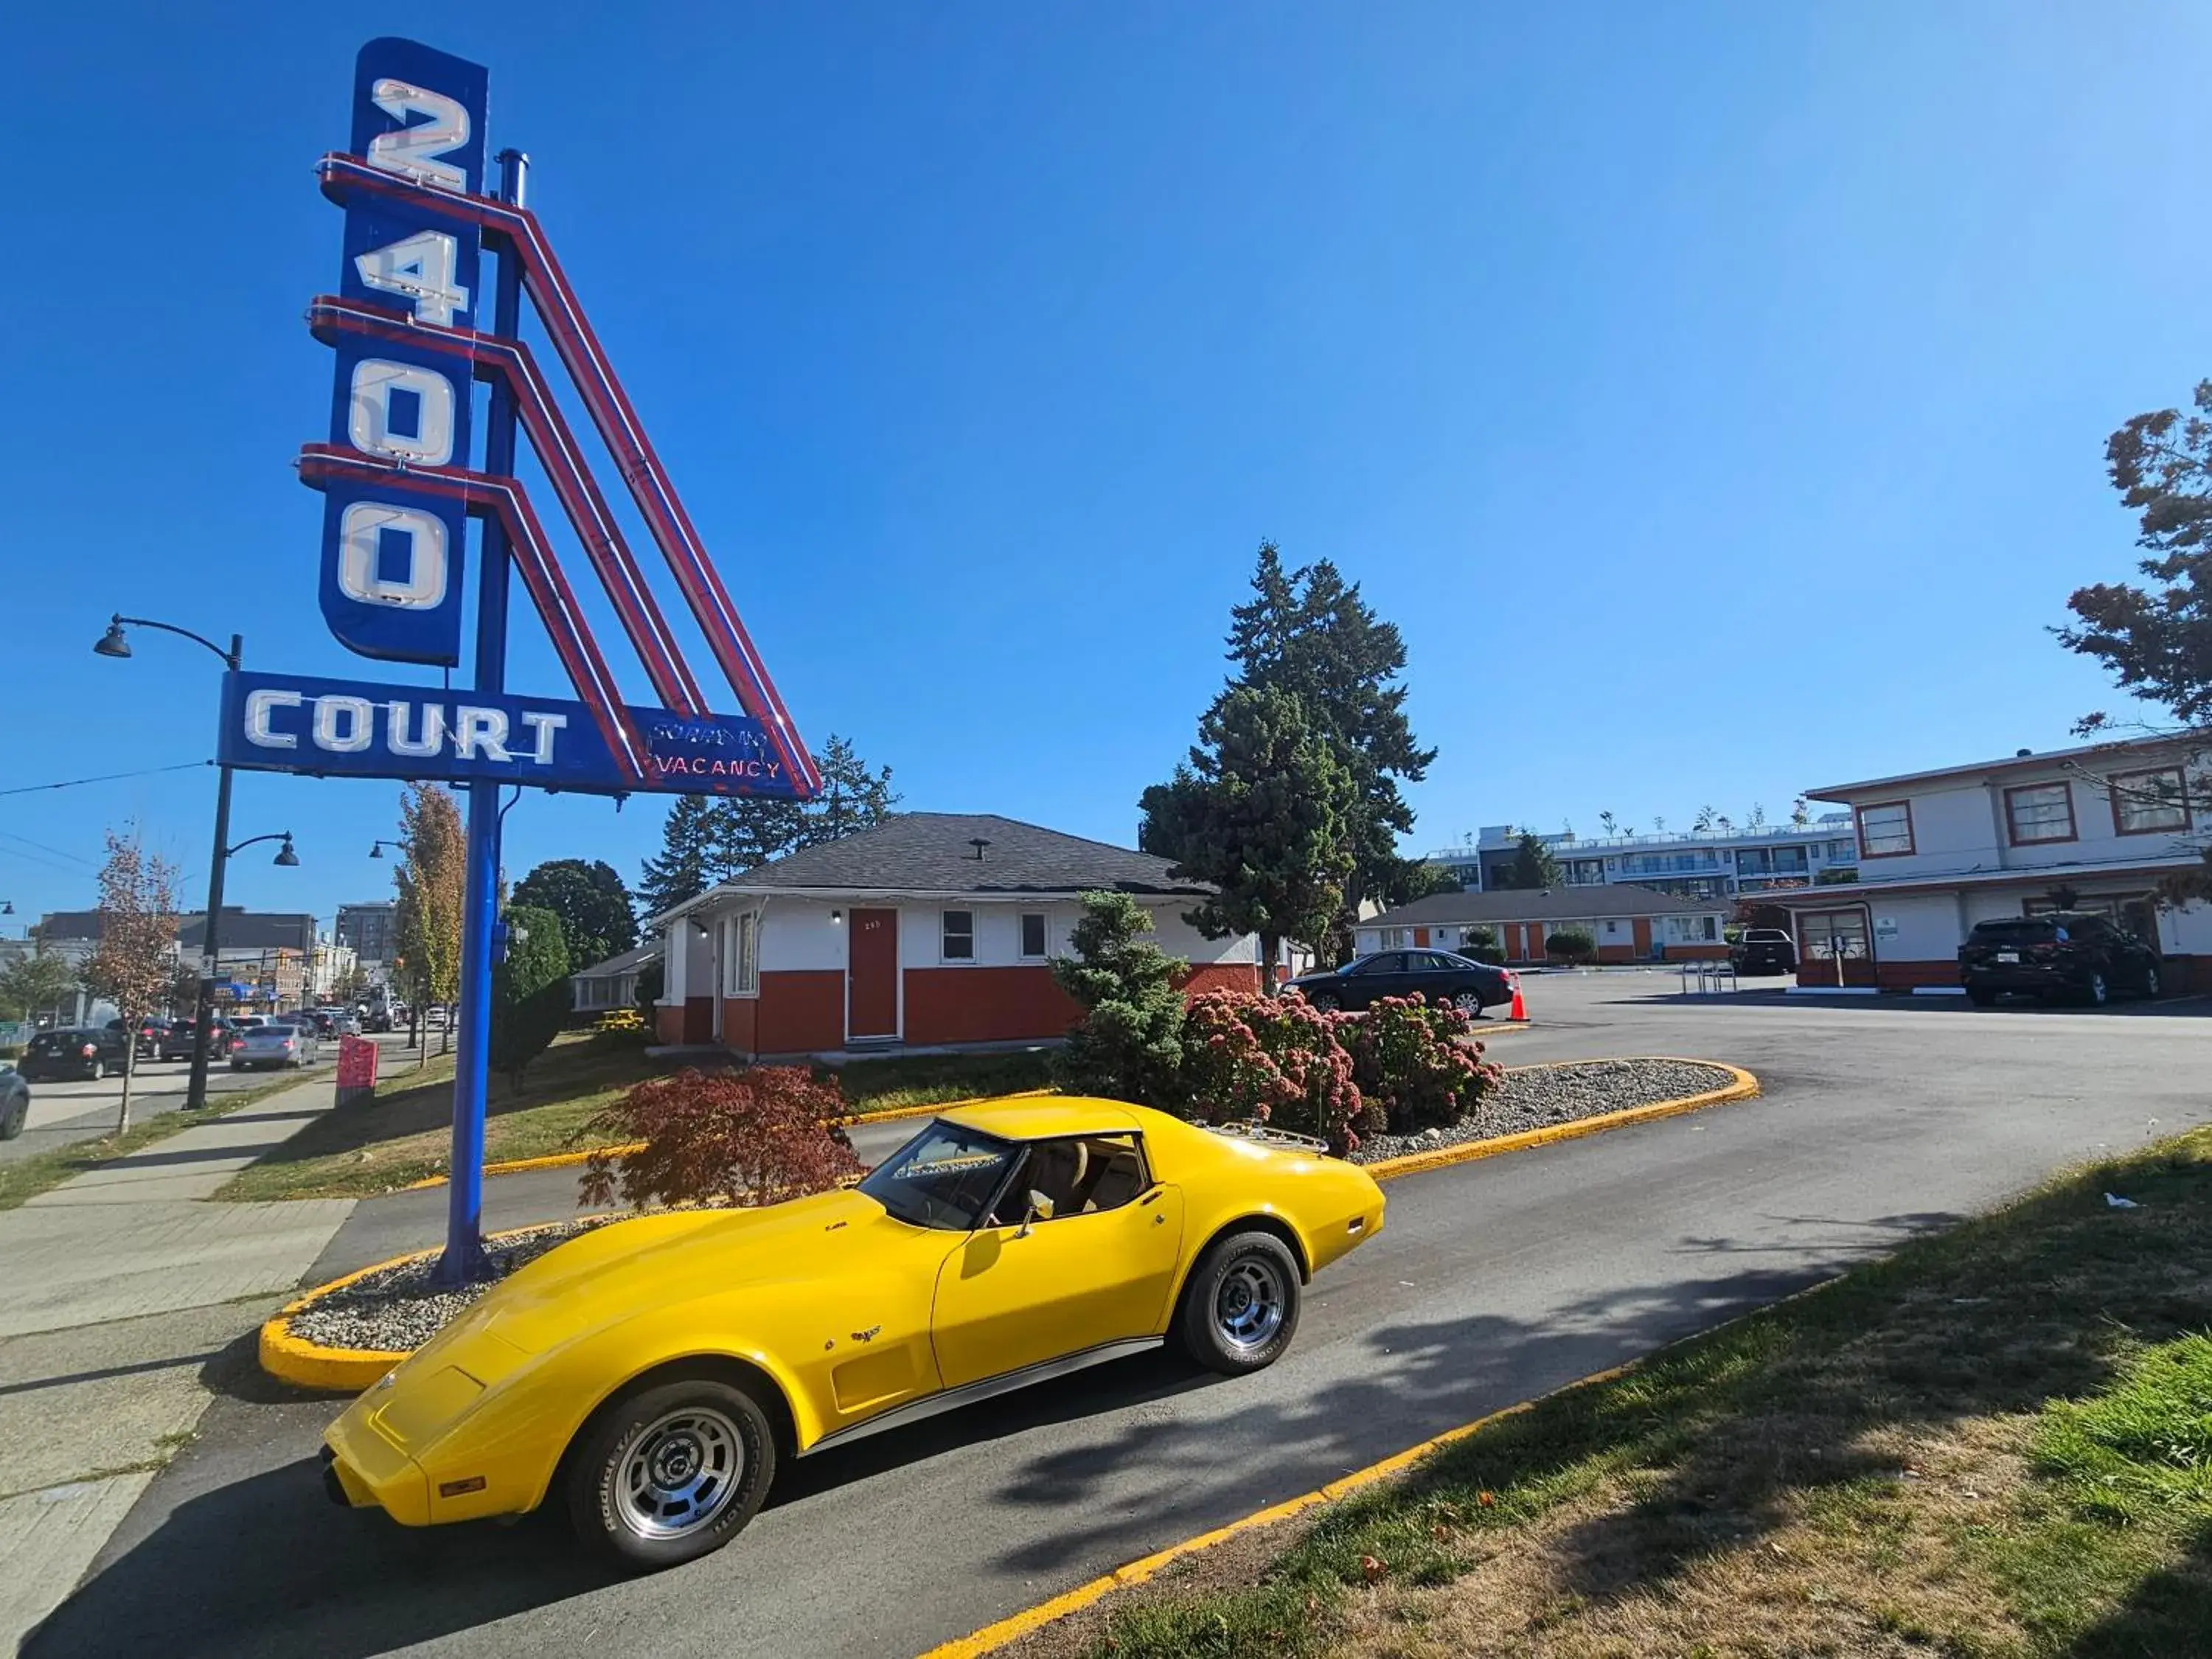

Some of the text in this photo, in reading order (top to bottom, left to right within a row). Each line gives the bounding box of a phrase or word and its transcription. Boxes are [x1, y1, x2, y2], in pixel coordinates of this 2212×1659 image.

[337, 77, 470, 611] 2400
[244, 689, 567, 765] COURT
[655, 756, 779, 778] VACANCY
